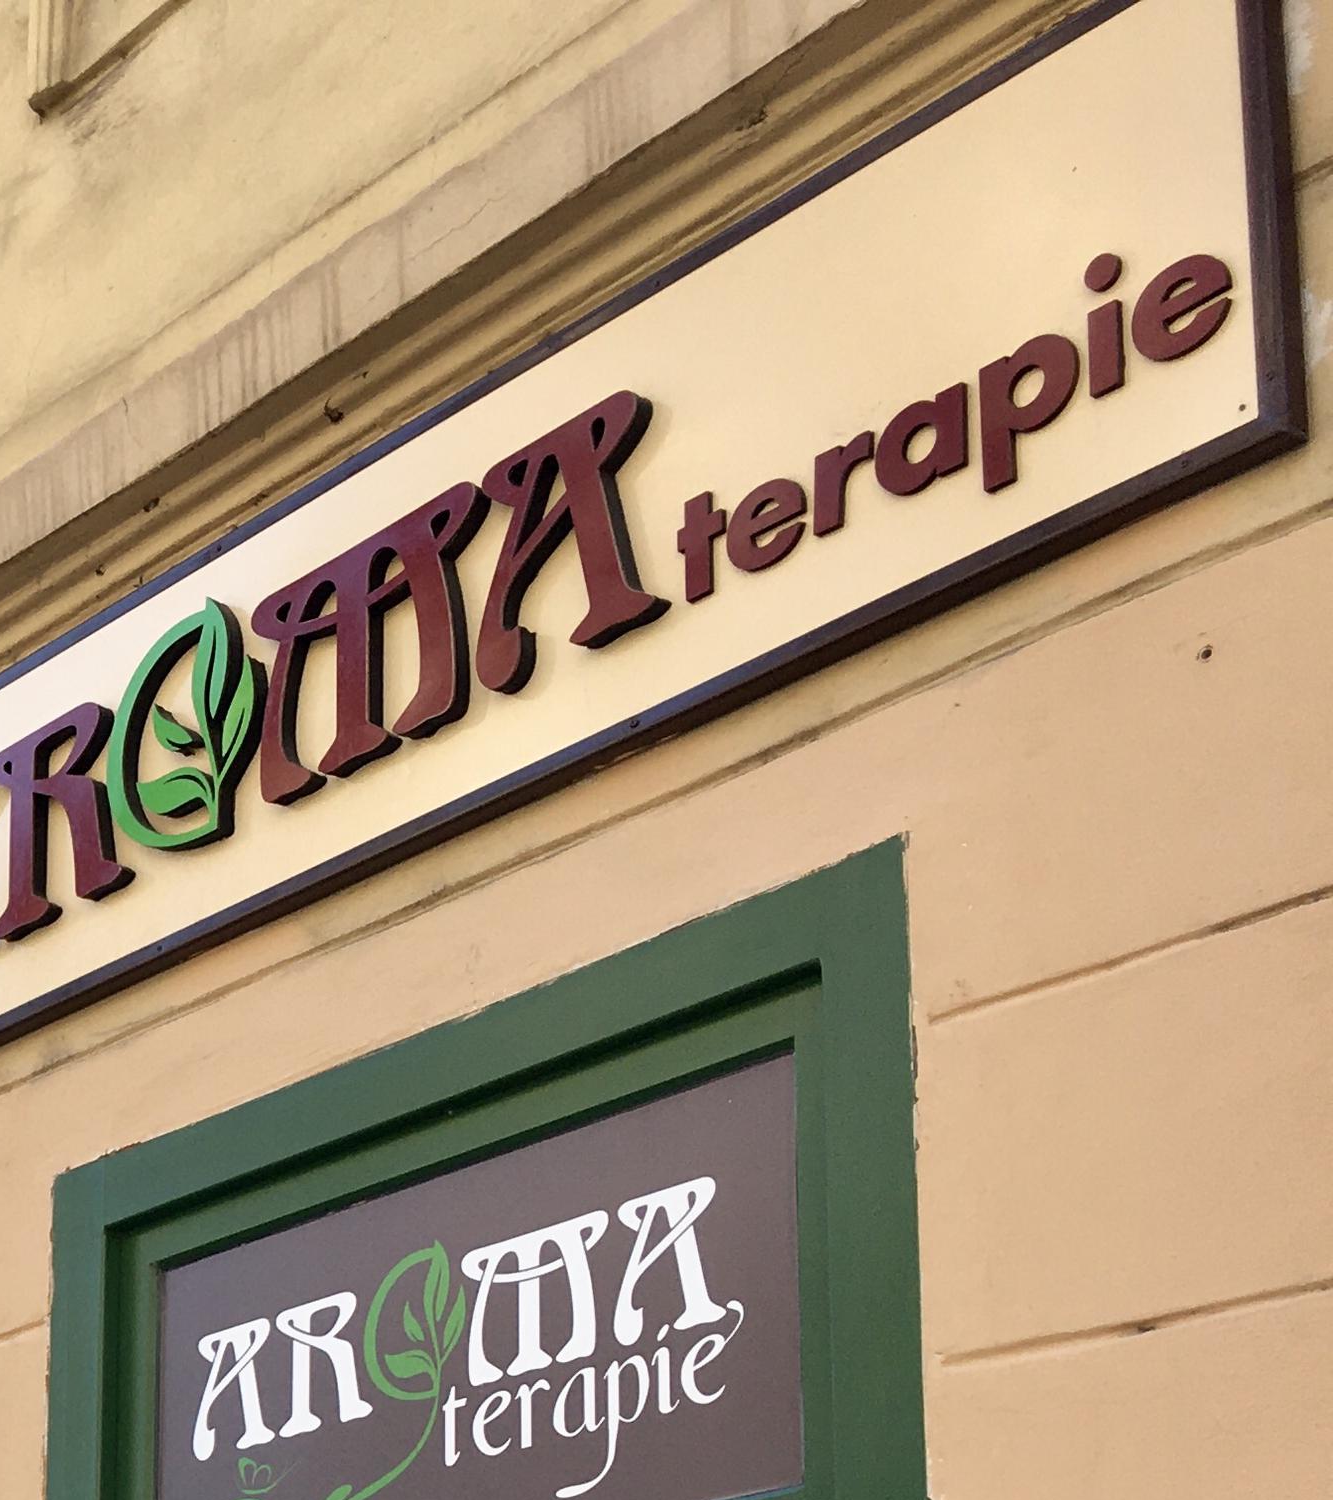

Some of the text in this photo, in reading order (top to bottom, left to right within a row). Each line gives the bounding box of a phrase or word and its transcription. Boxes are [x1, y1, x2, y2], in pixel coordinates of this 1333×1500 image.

[678, 252, 1234, 605] terapie
[192, 1175, 728, 1462] AROMA
[441, 1300, 745, 1499] terapie
